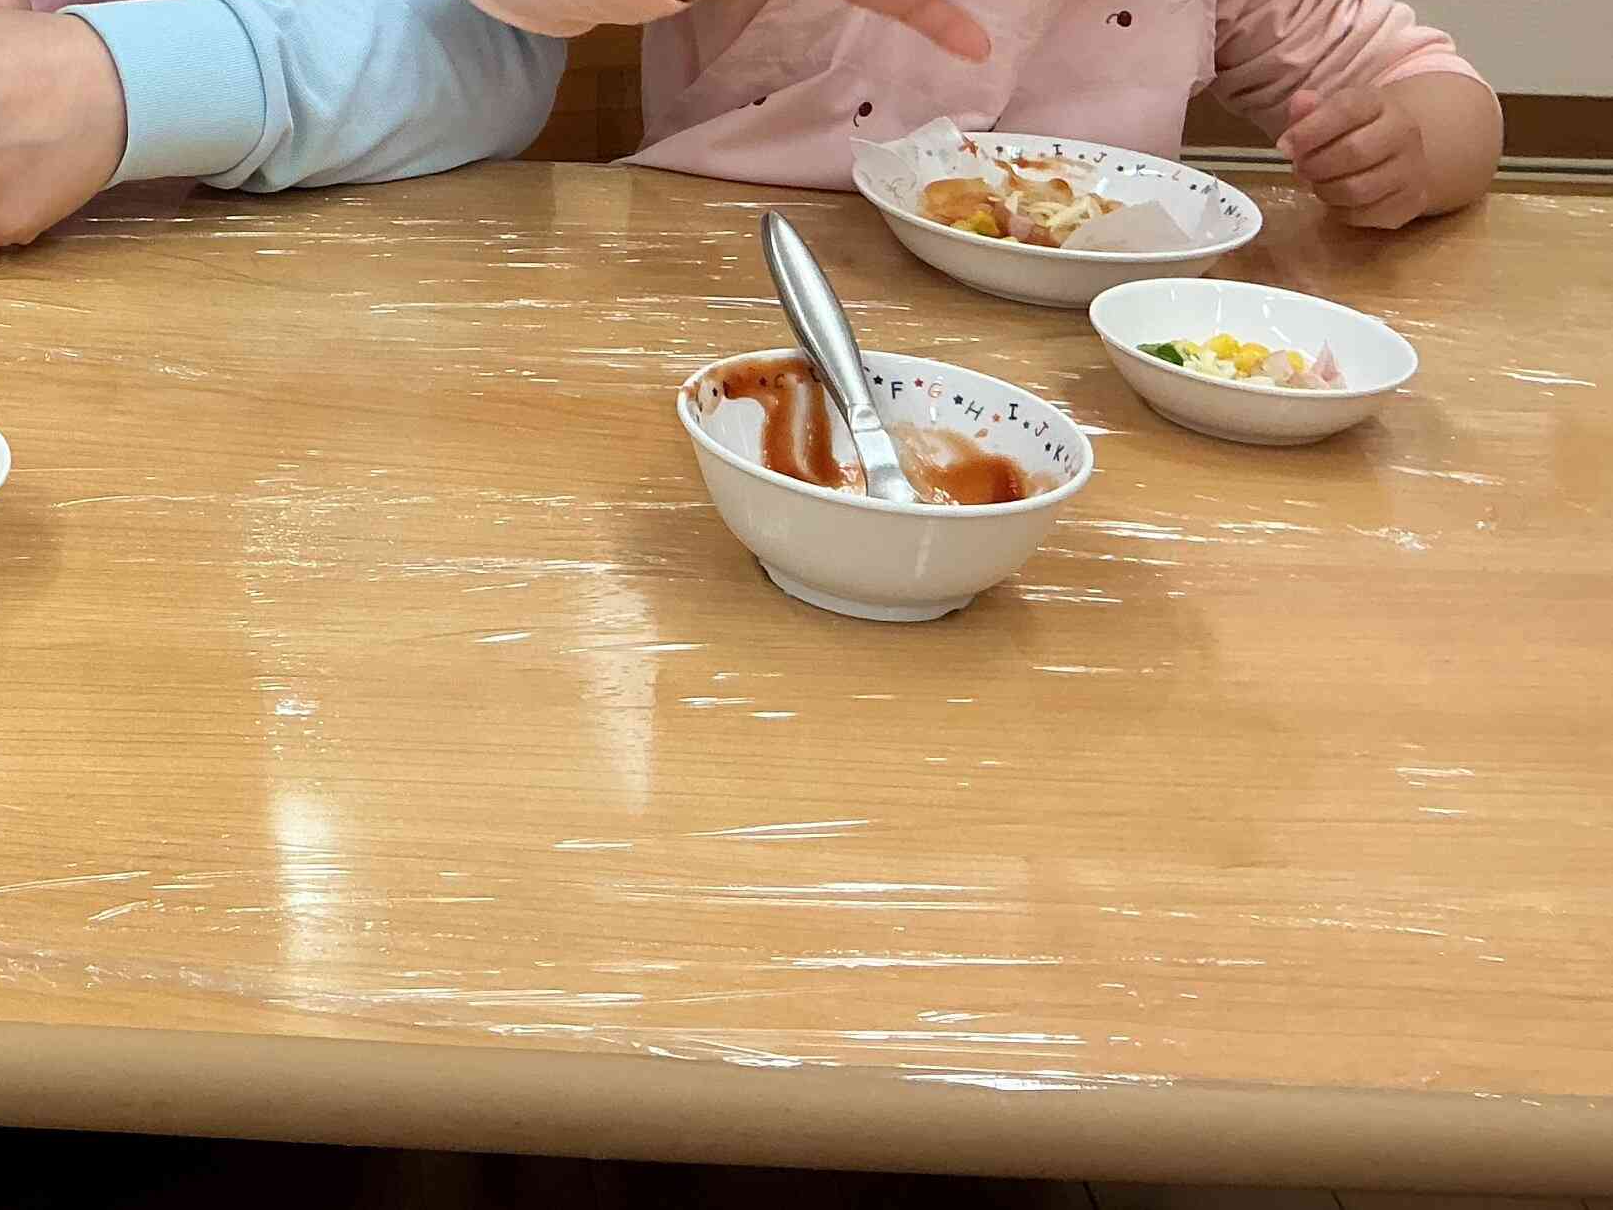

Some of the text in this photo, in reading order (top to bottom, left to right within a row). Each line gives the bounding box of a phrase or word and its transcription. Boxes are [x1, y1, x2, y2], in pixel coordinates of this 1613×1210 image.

[890, 380, 904, 400] F
[927, 382, 943, 399] G
[964, 400, 985, 421] H
[1008, 402, 1019, 421] I
[1034, 421, 1050, 438] J
[1053, 443, 1066, 463] K
